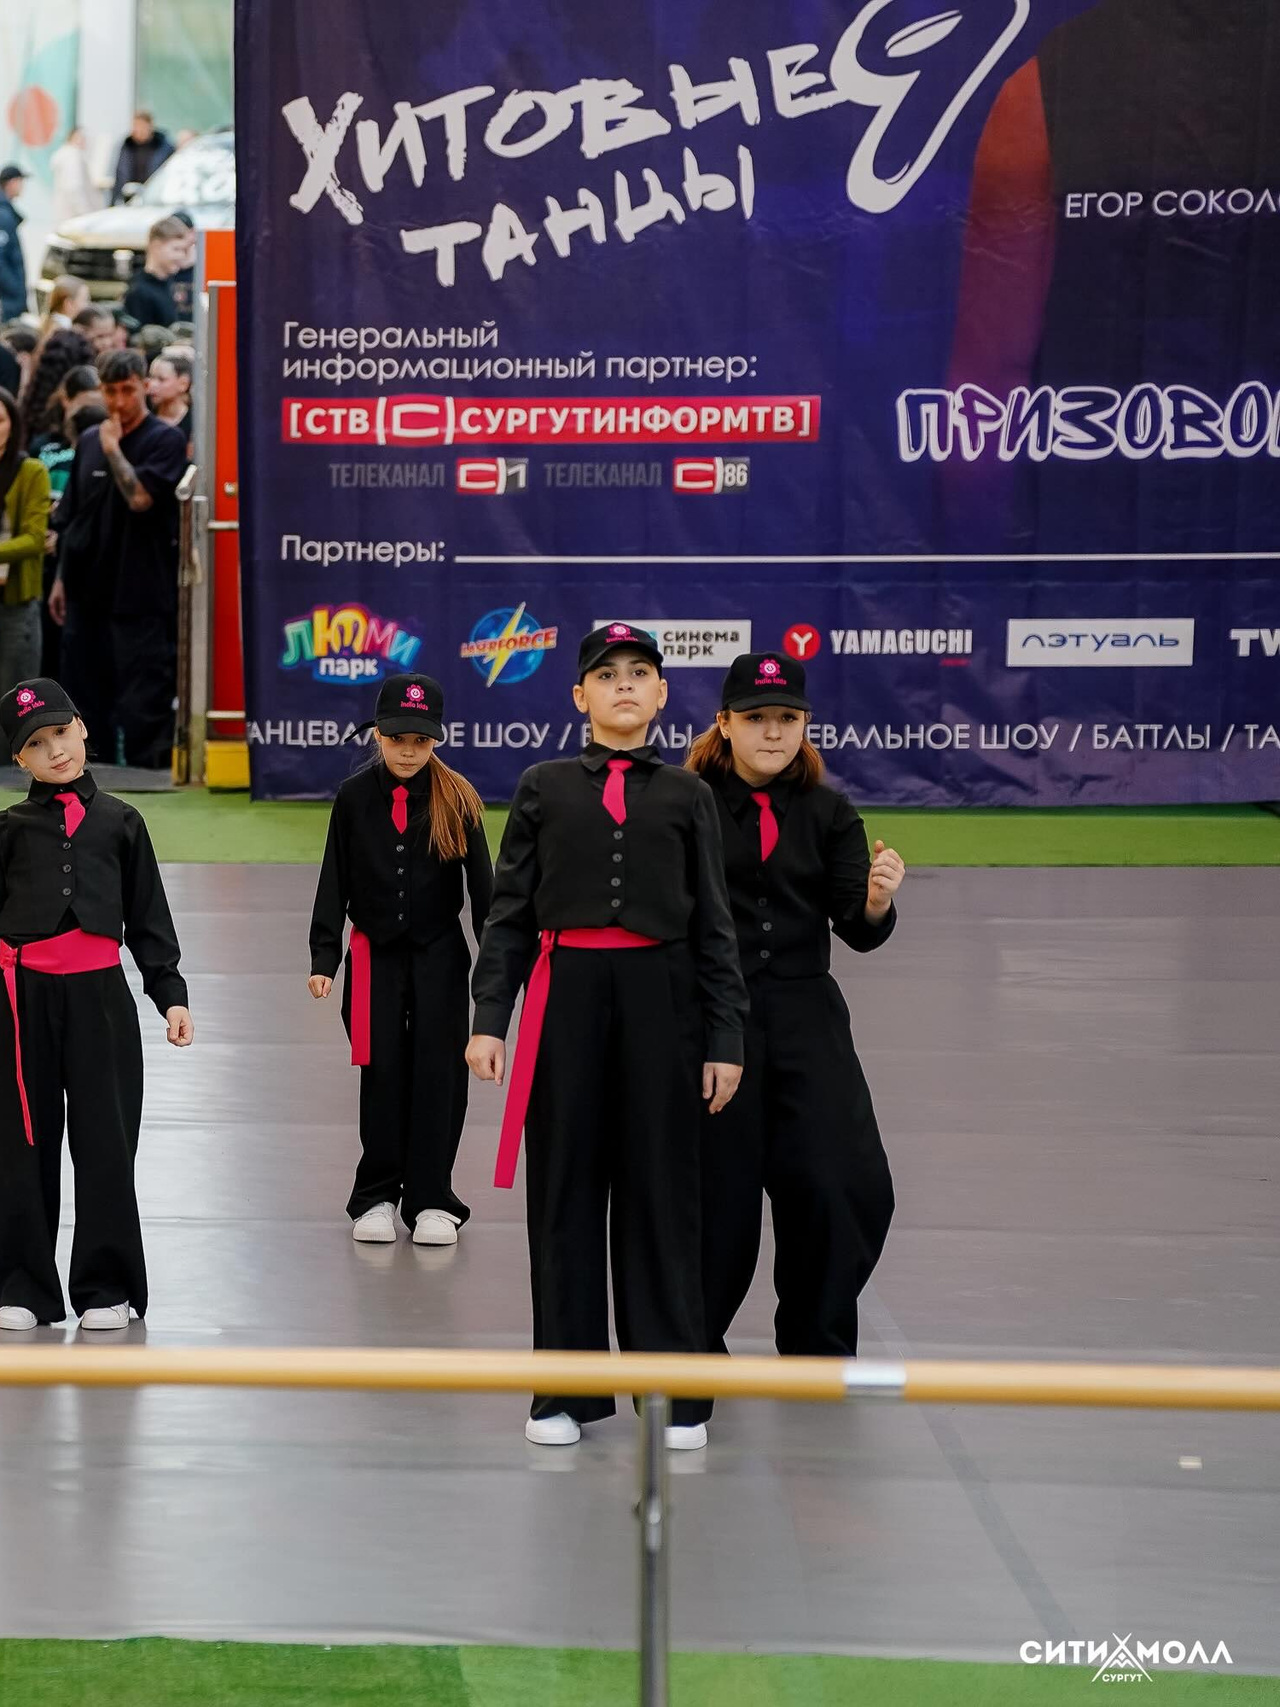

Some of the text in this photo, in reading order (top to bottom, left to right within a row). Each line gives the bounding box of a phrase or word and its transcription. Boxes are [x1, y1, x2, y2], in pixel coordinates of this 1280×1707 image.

[282, 43, 832, 225] ХИТОВЫЕ
[401, 145, 755, 287] ТАНЦЫ
[1065, 187, 1280, 218] ЕГОР СОКОЛ
[283, 320, 499, 353] Генеральный
[283, 350, 758, 385] информационный партнер:
[895, 380, 1280, 462] ПРИЗОВО
[329, 462, 446, 488] ТЕЛЕКАНАЛ
[544, 461, 664, 488] ТЕЛЕКАНАЛ
[281, 534, 446, 567] Партнеры:
[282, 608, 421, 666] ЛЮМИ
[663, 630, 740, 642] синема
[663, 643, 714, 660] парк
[830, 628, 973, 656] YAMAGUCHI
[320, 658, 379, 680] парк
[474, 722, 551, 748] ШОУ
[979, 723, 1060, 750] ШОУ
[1092, 723, 1210, 751] БАТТЛЫ
